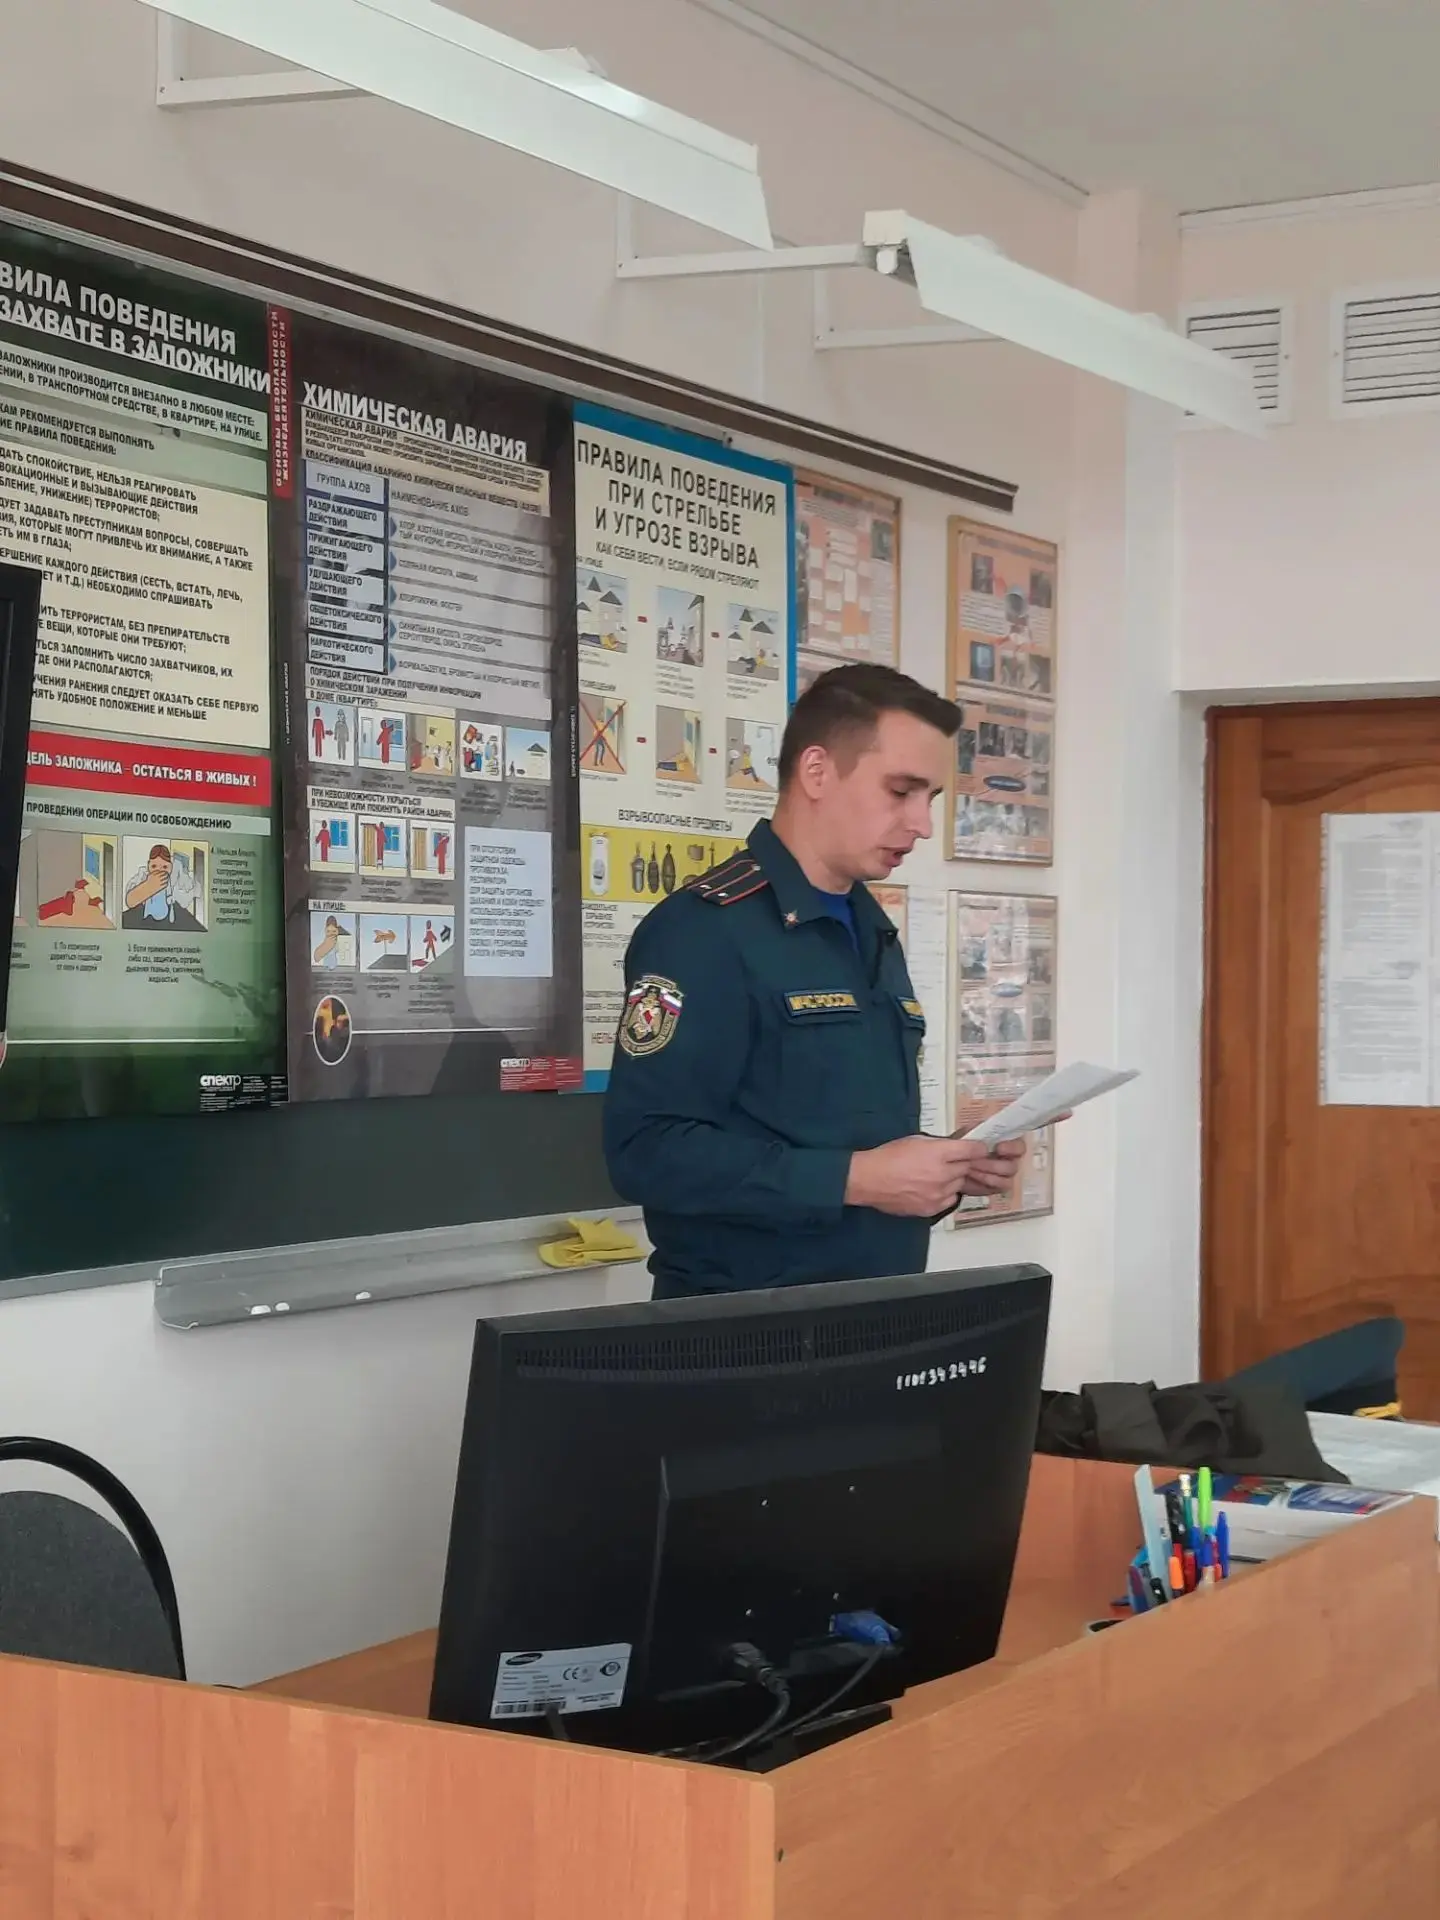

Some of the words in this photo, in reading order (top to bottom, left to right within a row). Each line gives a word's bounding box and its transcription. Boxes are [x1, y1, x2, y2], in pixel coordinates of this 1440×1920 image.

[0, 261, 71, 308] ВИЛА
[80, 285, 236, 355] ПОВЕДЕНИЯ
[0, 295, 104, 346] ЗАХВАТЕ
[111, 327, 125, 352] В
[132, 333, 271, 394] ЗАЛОЖНИКИ
[28, 372, 34, 383] В
[37, 374, 109, 402] ТРАНСПОРТНОМ
[112, 394, 159, 417] СРЕДСТВЕ,
[171, 409, 218, 432] КВАРТИРЕ,
[220, 421, 232, 433] НА
[59, 367, 130, 393] ПРОИЗВОДИТСЯ
[132, 386, 179, 406] ВНЕЗАПНО
[190, 401, 224, 418] ЛЮБОМ
[0, 403, 18, 416] КАМ
[20, 408, 96, 435] РЕКОМЕНДУЕТСЯ
[99, 428, 155, 450] ВЫПОЛНЯТЬ
[15, 422, 58, 440] ПРАВИЛА
[61, 434, 116, 455] ПОВЕДЕНИЯ:
[304, 381, 446, 440] ХИМИЧЕСКАЯ
[452, 424, 527, 462] АВАРИЯ
[306, 409, 362, 432] ХИМИЧЕСКАЯ
[365, 424, 398, 440] АВАРИЯ
[0, 448, 24, 461] ДАТЬ
[26, 454, 94, 479] СПОКОЙСТВИЕ,
[97, 470, 132, 486] НЕЛЬЗЯ
[134, 479, 197, 501] РЕАГИРОВАТЬ
[306, 448, 372, 472] КЛАССИФИКАЦИЯ
[0, 462, 69, 485] ВОКАЦИОННЫЕ
[72, 479, 78, 487] И
[80, 481, 148, 503] ВЫЗЫВАЮЩИЕ
[150, 497, 198, 515] ДЕЙСТВИЯ
[316, 473, 346, 488] ГРУППА
[348, 478, 371, 494] АХОВ
[578, 440, 664, 486] ПРАВИЛА
[670, 467, 776, 516] ПОВЕДЕНИЯ
[95, 498, 160, 523] ТЕРРОРИСТОВ;
[308, 499, 377, 522] РАЗДРАЖАЮЩЕГО
[308, 512, 348, 528] ДЕЙСТВИЯ
[608, 480, 644, 510] ПРИ
[652, 492, 741, 536] СТРЕЛЬБЕ
[17, 530, 30, 541] ИМ
[33, 534, 38, 542] В
[42, 536, 72, 551] ГЛАЗА;
[20, 516, 62, 533] КОТОРЫЕ
[66, 525, 94, 539] МОГУТ
[96, 532, 142, 549] ПРИВЛЕЧЬ
[146, 542, 158, 552] ИХ
[160, 545, 212, 565] ВНИМАНИЕ,
[215, 556, 222, 565] А
[224, 558, 254, 571] ТАКЖЕ
[24, 503, 70, 520] ЗАДАВАТЬ
[73, 513, 142, 535] ПРЕСТУПНИКАМ
[146, 528, 192, 547] ВОПРОСЫ,
[195, 539, 249, 557] СОВЕРШАТЬ
[596, 506, 606, 530] И
[614, 511, 682, 550] УГРОЗЕ
[689, 531, 759, 568] ВЗРЫВА
[308, 545, 347, 560] ДЕЙСТВИЯ
[46, 556, 88, 572] КАЖДОГО
[91, 565, 138, 581] ДЕЙСТВИЯ
[140, 574, 174, 590] (СЕСТЬ,
[176, 581, 214, 597] ВСТАТЬ,
[217, 589, 242, 602] ЛЕЧЬ,
[56, 573, 62, 583] И
[87, 579, 148, 598] НЕОБХОДИМО
[151, 592, 213, 609] СПРАШИВАТЬ
[46, 621, 74, 635] ВЕЩИ,
[77, 626, 118, 640] КОТОРЫЕ
[121, 633, 140, 644] ОНИ
[143, 637, 186, 653] ТРЕБУЮТ;
[61, 609, 126, 629] ТЕРРОРИСТАМ,
[129, 621, 145, 630] БЕЗ
[148, 624, 230, 644] ПРЕПИРАТЕЛЬСТВ
[53, 656, 70, 667] ОНИ
[74, 659, 153, 682] РАСПОЛАГАЮТСЯ;
[62, 643, 114, 659] ЗАПОМНИТЬ
[117, 652, 147, 664] ЧИСЛО
[150, 657, 218, 676] ЗАХВАТЧИКОВ,
[221, 668, 233, 677] ИХ
[58, 692, 97, 705] УДОБНОЕ
[100, 698, 156, 713] ПОЛОЖЕНИЕ
[158, 706, 164, 714] И
[166, 707, 207, 720] МЕНЬШЕ
[69, 679, 108, 692] РАНЕНИЯ
[112, 685, 150, 698] СЛЕДУЕТ
[153, 691, 194, 704] ОКАЗАТЬ
[196, 697, 220, 707] СЕБЕ
[223, 701, 259, 713] ПЕРВУЮ
[55, 754, 122, 774] ЗАЛОЖНИКА
[132, 764, 192, 781] ОСТАТЬСЯ
[195, 769, 203, 782] В
[206, 771, 250, 786] ЖИВЫХ
[26, 802, 84, 817] ПРОВЕДЕНИИ
[86, 808, 133, 822] ОПЕРАЦИИ
[136, 812, 148, 823] ПО
[150, 814, 232, 829] ОСВОБОЖДЕНИЮ
